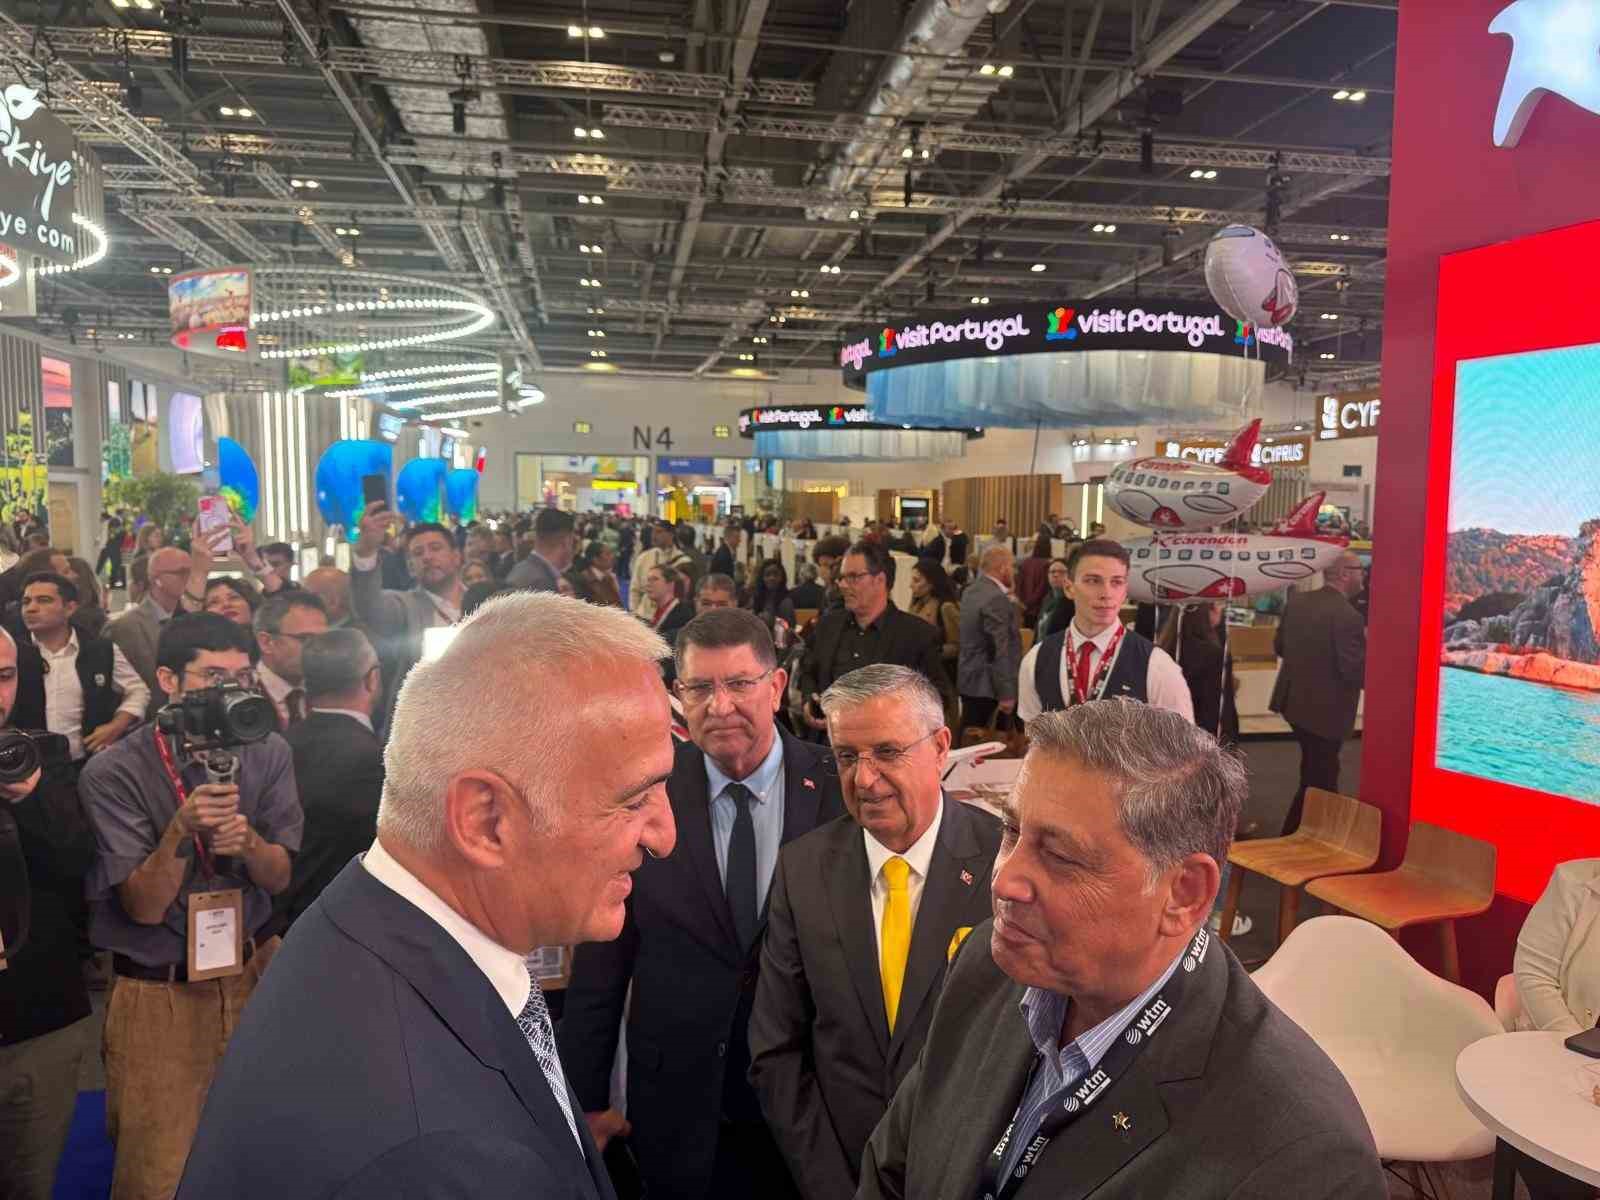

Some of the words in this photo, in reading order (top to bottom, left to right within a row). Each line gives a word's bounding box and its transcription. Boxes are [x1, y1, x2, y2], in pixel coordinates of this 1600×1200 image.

[632, 425, 675, 451] N4
[1260, 443, 1304, 464] CYPRUS
[1191, 927, 1207, 958] wtm
[1137, 1000, 1167, 1031] wtm
[1075, 1069, 1107, 1100] wtm
[1023, 1135, 1046, 1164] wtm
